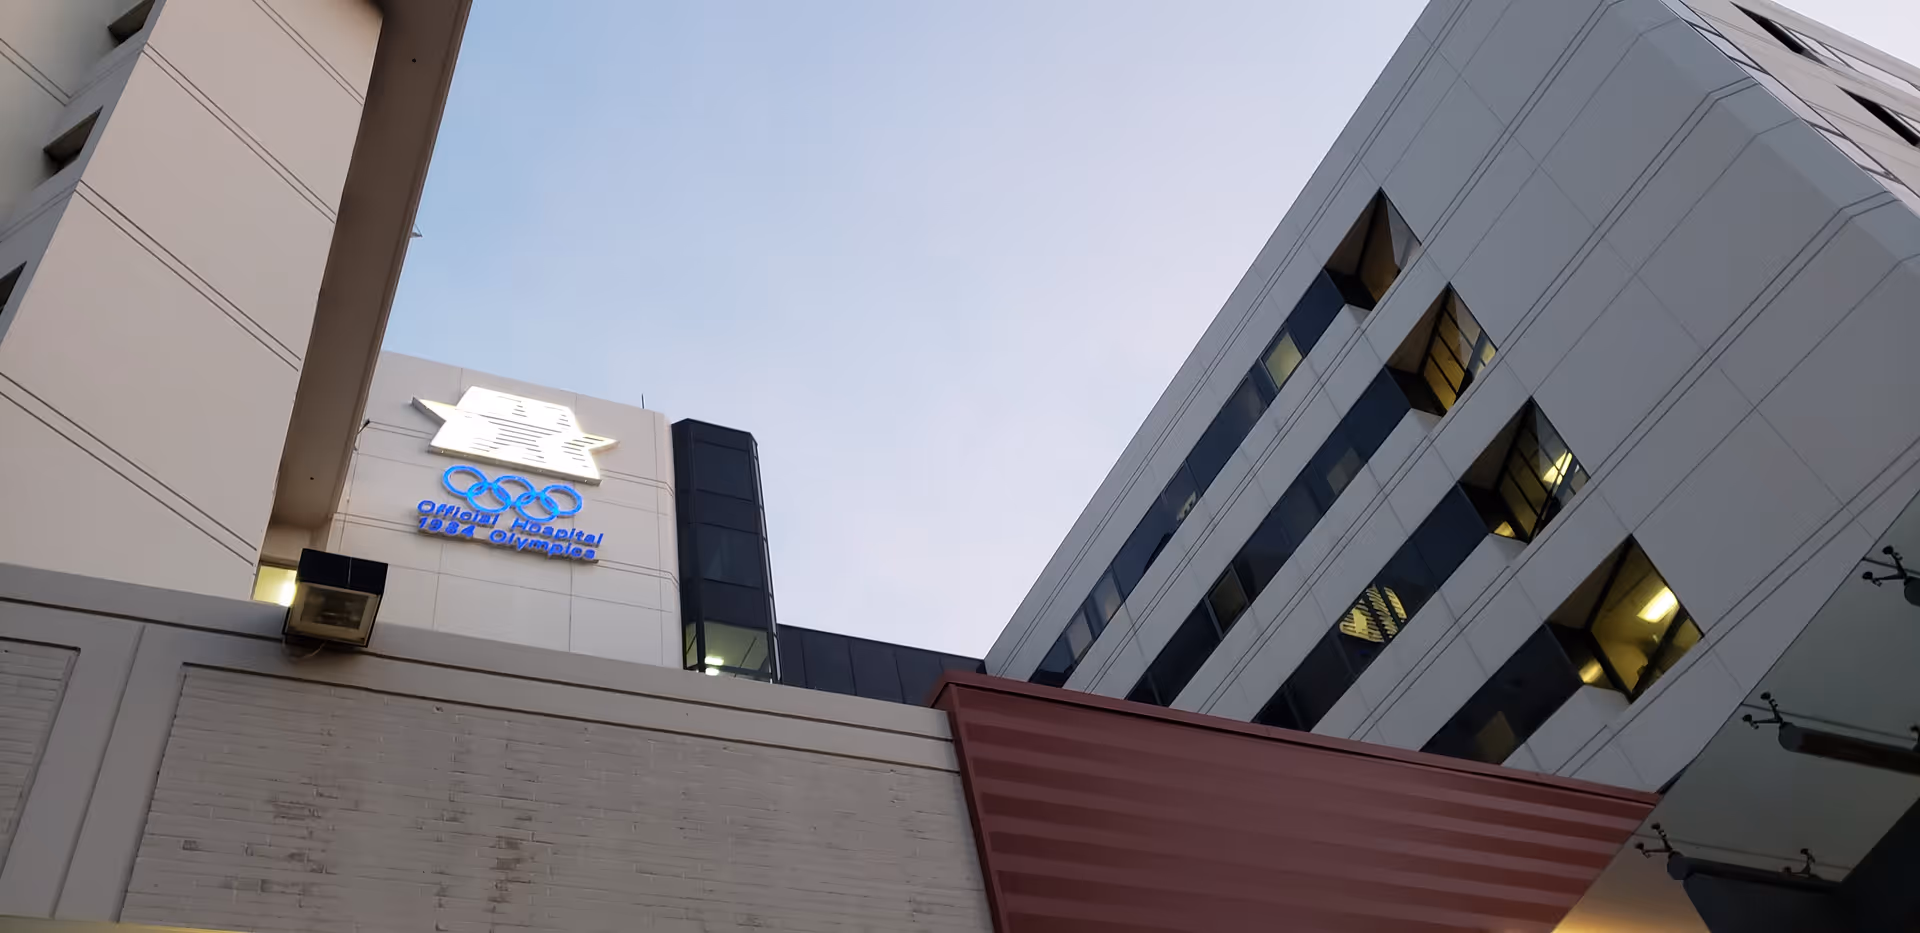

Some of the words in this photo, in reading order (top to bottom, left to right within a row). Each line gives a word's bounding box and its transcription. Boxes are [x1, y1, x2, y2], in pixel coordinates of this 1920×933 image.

[417, 500, 500, 526] Official
[511, 517, 604, 545] Hospital
[418, 516, 476, 537] 1984
[489, 529, 596, 560] Olympics
